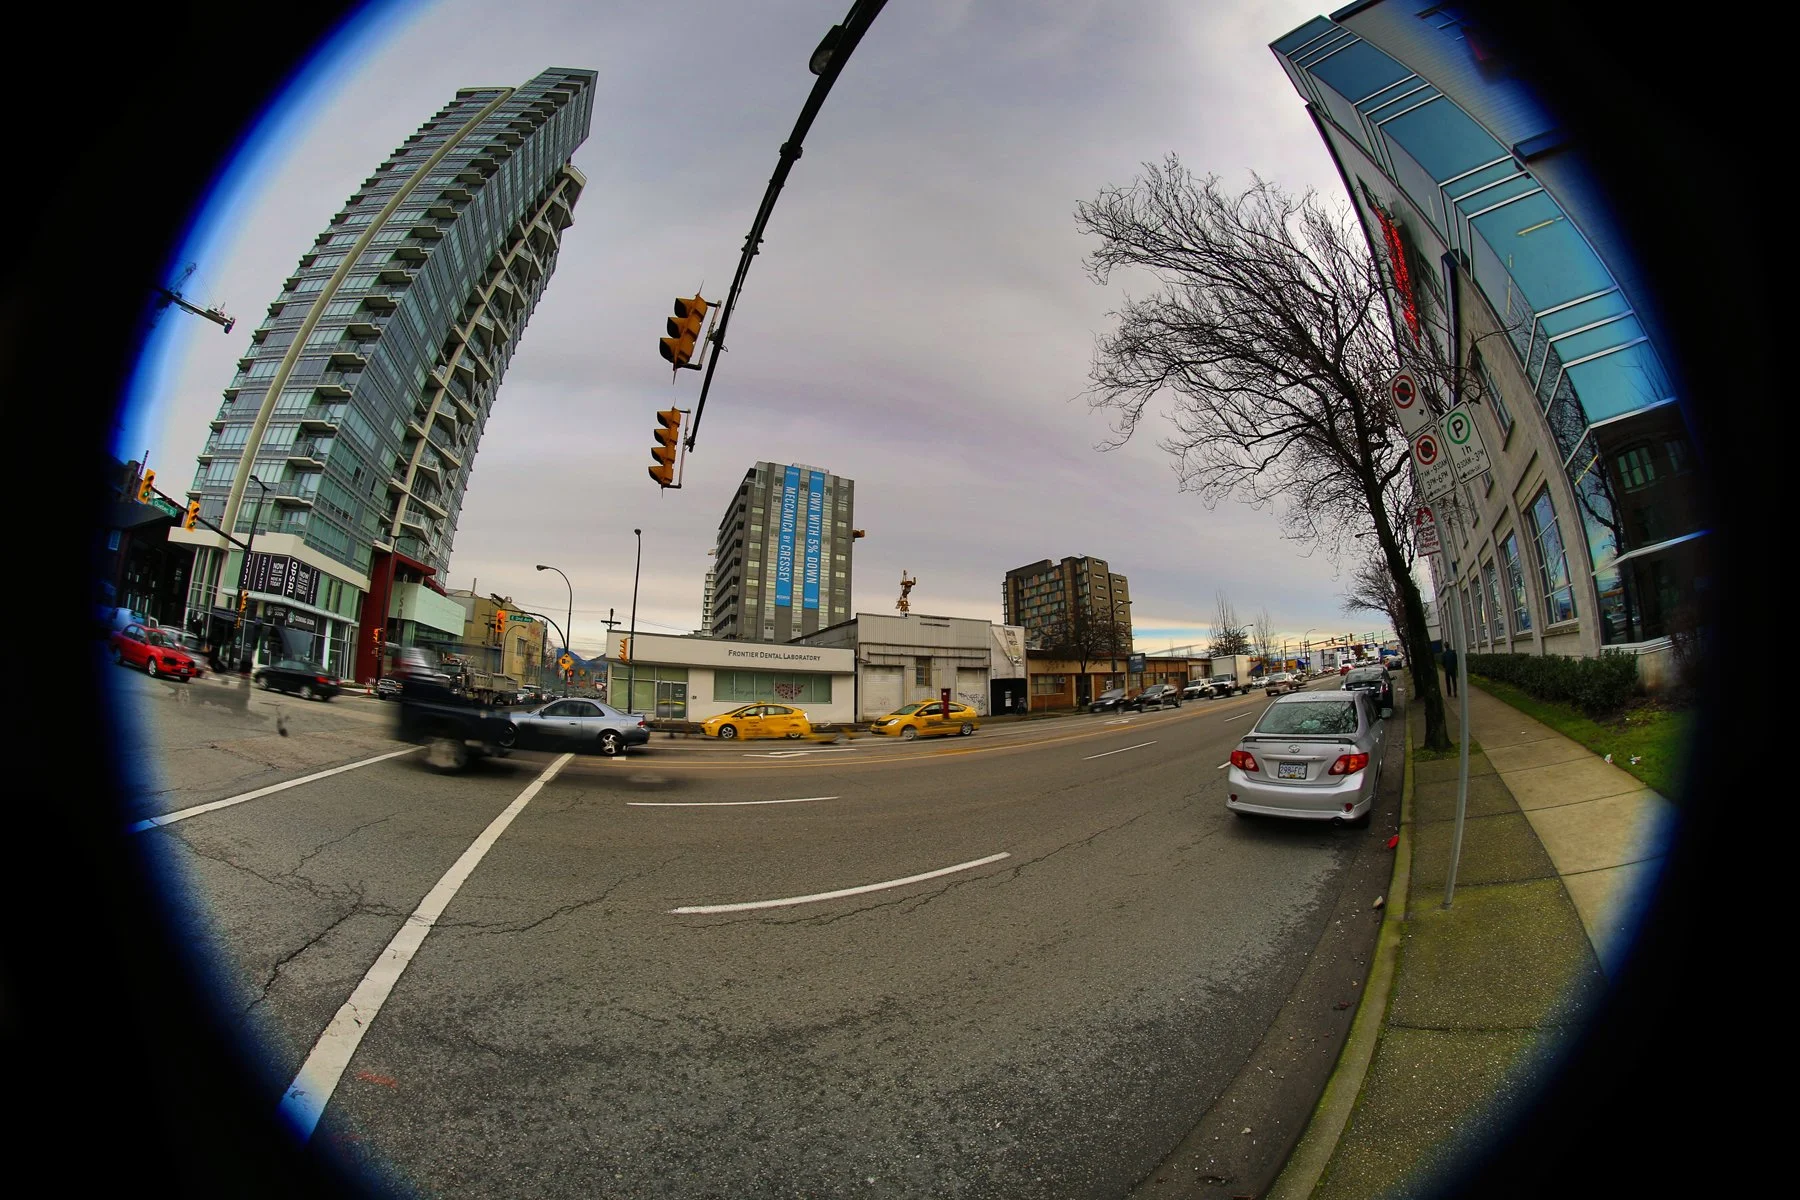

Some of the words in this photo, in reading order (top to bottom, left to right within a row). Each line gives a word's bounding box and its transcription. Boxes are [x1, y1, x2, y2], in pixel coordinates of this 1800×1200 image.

[1452, 419, 1463, 439] P
[1461, 445, 1472, 456] 1h
[782, 486, 796, 533] MECCANICA
[810, 492, 821, 512] OWN
[808, 514, 820, 536] WITH
[783, 535, 790, 544] BY
[807, 539, 819, 553] 5%
[273, 562, 285, 570] NOW
[778, 545, 791, 583] CRESSEY
[806, 557, 818, 584] DOWN
[728, 649, 758, 658] FRONTIER
[760, 651, 782, 660] DENTAL
[783, 653, 821, 661] LABORATORY
